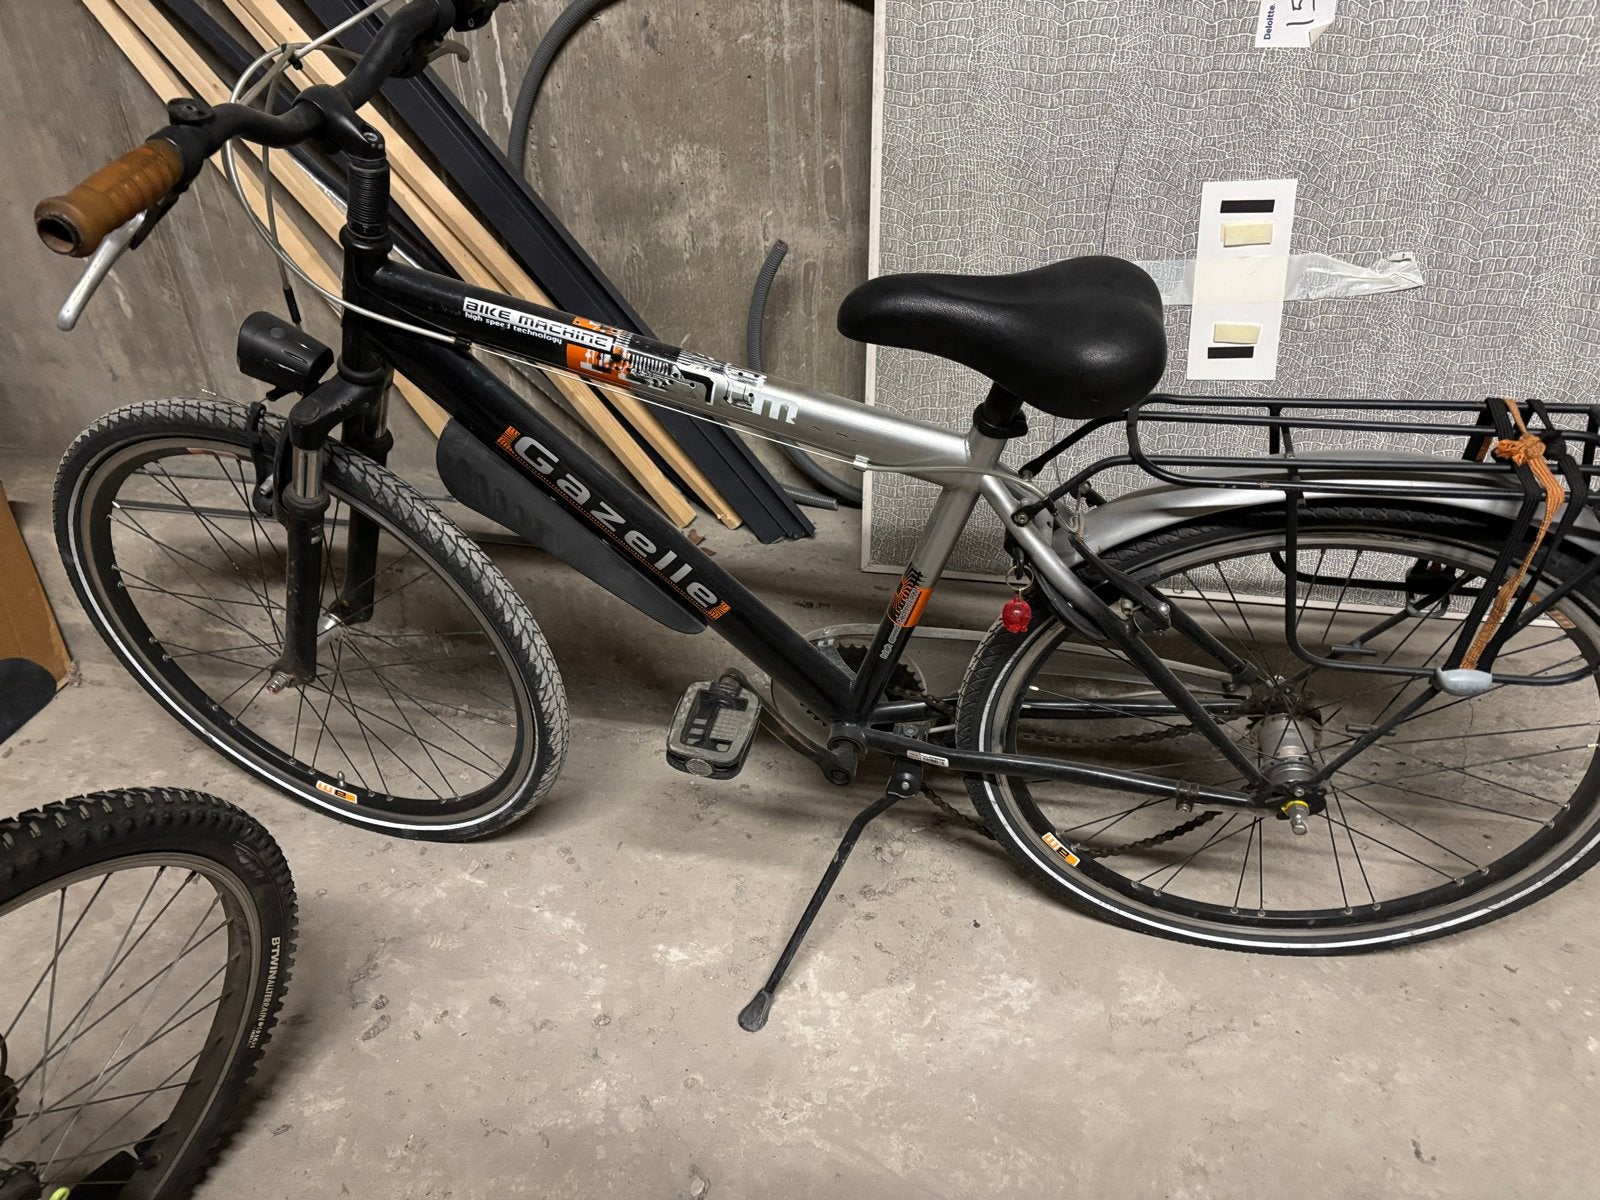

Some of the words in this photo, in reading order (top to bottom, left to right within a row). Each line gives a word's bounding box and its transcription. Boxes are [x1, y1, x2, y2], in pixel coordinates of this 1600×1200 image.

[465, 300, 512, 321] BIKE
[465, 311, 483, 323] high
[513, 324, 563, 346] technology
[514, 436, 718, 608] Gazelle
